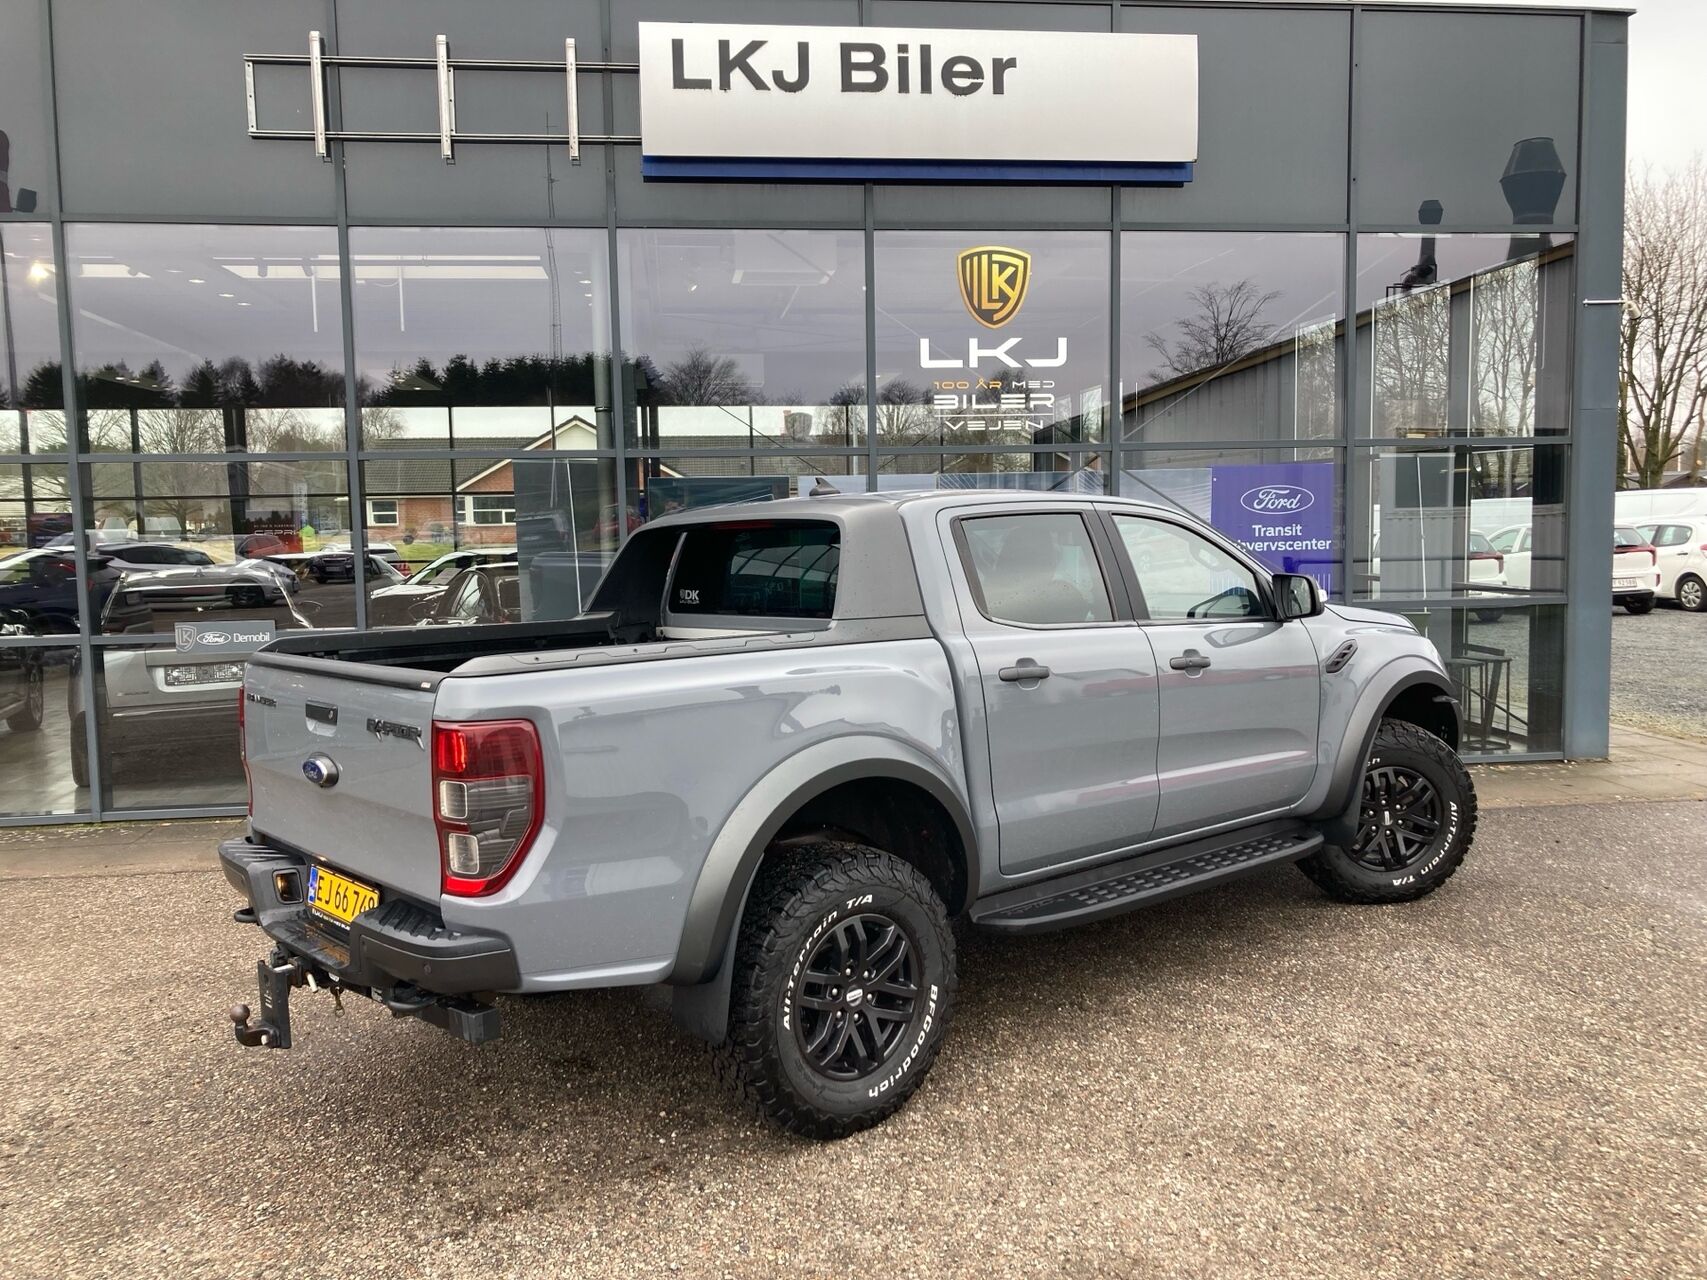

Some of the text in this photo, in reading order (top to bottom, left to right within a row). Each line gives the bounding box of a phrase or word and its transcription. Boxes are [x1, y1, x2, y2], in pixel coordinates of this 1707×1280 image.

[672, 38, 1017, 95] LKJ Biler
[919, 336, 1068, 369] LKJ
[933, 377, 1055, 389] 100 ÅR MED
[933, 393, 1055, 410] BILER
[944, 420, 1044, 431] VEJEN
[1253, 488, 1302, 509] Ford
[1252, 523, 1303, 537] Transit
[233, 631, 270, 643] Demobil
[846, 894, 873, 908] T/A
